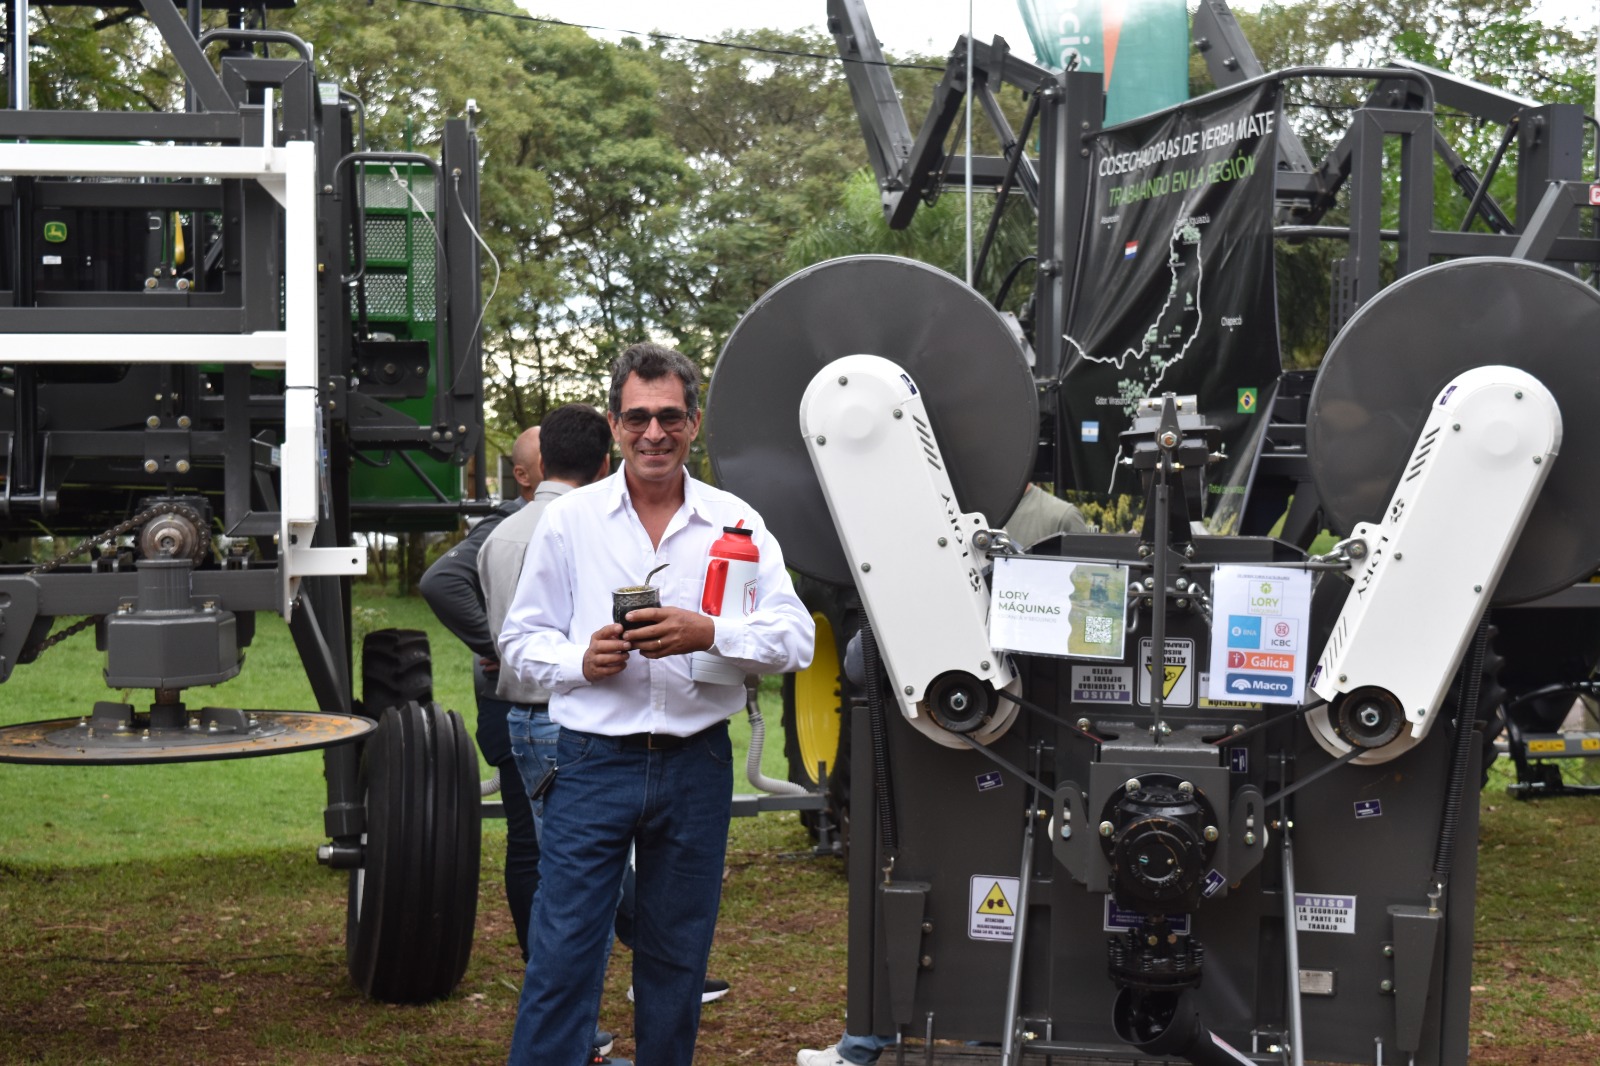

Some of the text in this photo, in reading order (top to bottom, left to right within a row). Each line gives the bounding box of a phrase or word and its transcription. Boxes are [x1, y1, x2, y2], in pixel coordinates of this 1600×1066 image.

[1099, 111, 1275, 177] COSECHADORAS DE YERBA MATE
[1109, 150, 1256, 207] TRABAJANDO EN LA REGIÓN
[941, 493, 968, 557] LORY
[1358, 536, 1389, 600] LORY
[999, 590, 1029, 600] LORY
[1251, 597, 1279, 607] LORY
[998, 602, 1061, 615] MÁQUINAS
[1271, 639, 1291, 647] ICBC
[1250, 655, 1289, 669] Galicia
[1252, 680, 1288, 691] Macro
[1082, 691, 1120, 699] AVISO
[1305, 897, 1344, 907] AVISO
[1309, 907, 1348, 915] SEGURIDAD
[1308, 923, 1338, 931] TRABAJO
